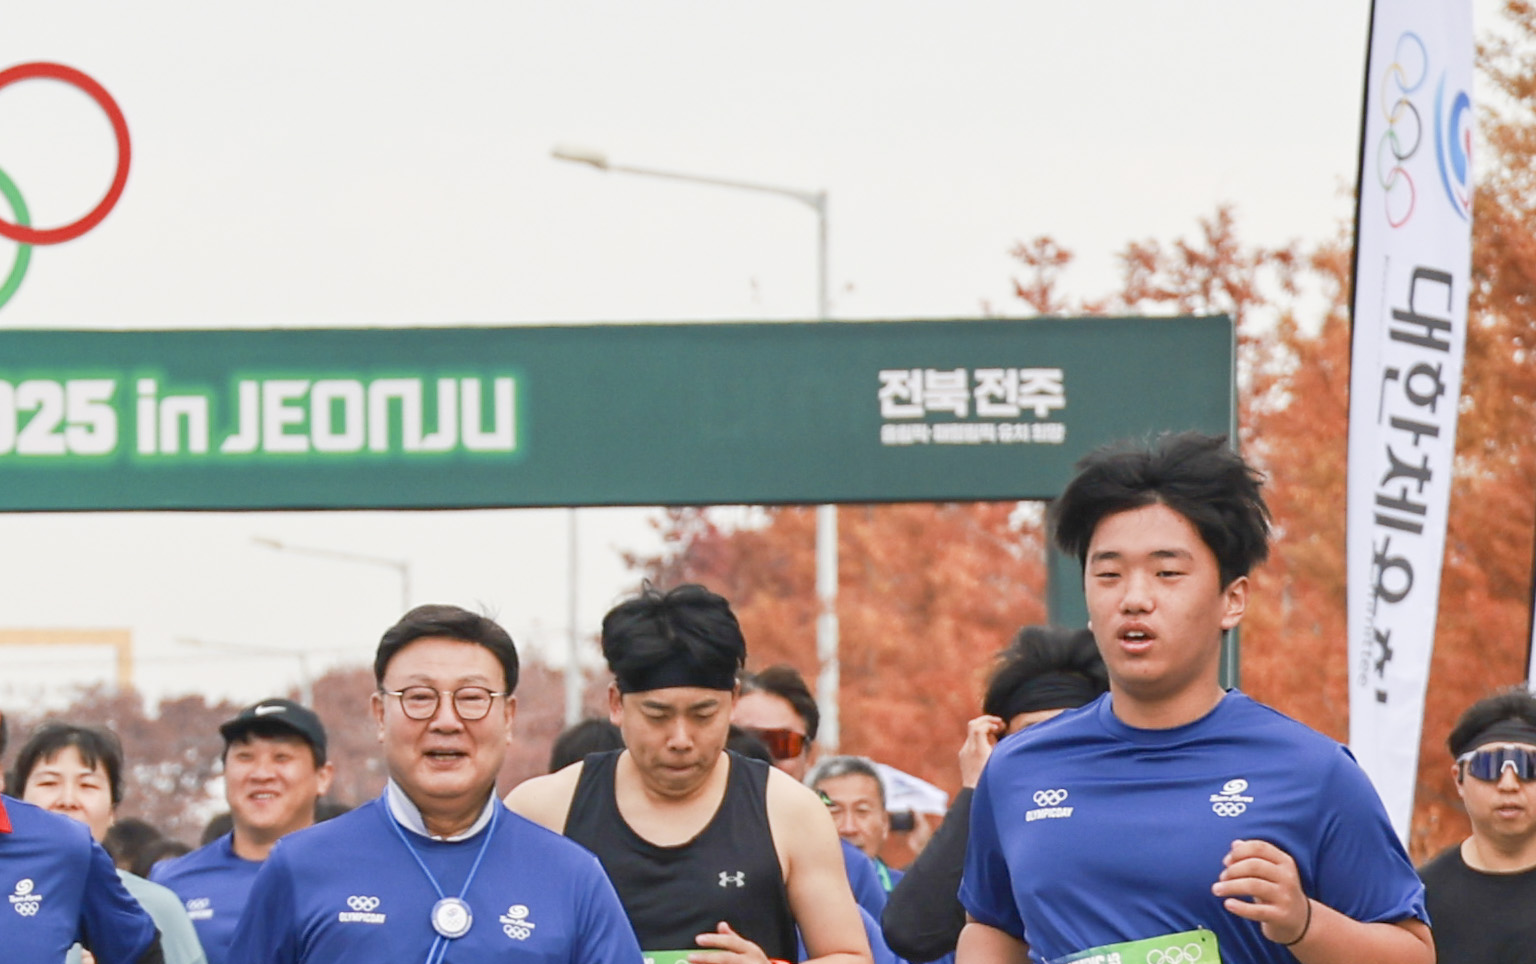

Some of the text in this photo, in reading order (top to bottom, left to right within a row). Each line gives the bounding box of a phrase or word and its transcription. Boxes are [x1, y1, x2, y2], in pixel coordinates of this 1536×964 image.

[135, 377, 210, 455] in
[219, 377, 517, 454] JEONJU
[877, 367, 1067, 419] 전북 전주
